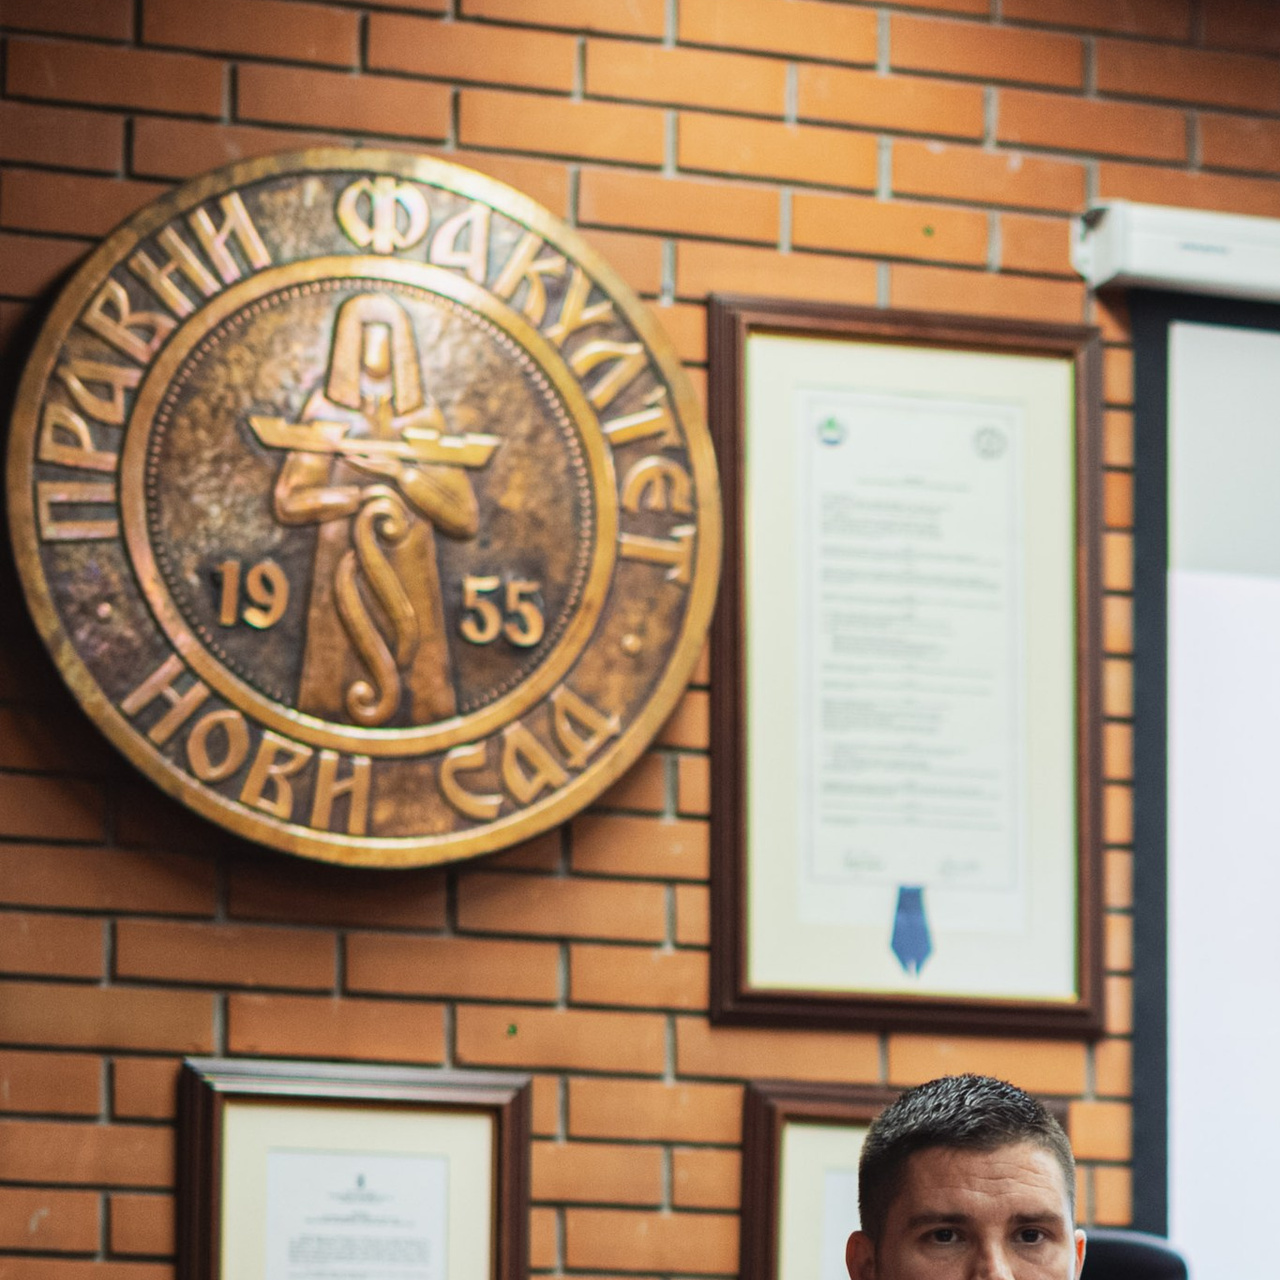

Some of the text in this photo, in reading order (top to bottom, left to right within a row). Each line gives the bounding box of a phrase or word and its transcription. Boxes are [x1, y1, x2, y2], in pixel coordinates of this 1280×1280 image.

[38, 178, 696, 583] ПРАВНИ ФАКУЛТЕТ
[213, 560, 544, 648] 19 55
[121, 654, 620, 834] НОВИ САД
